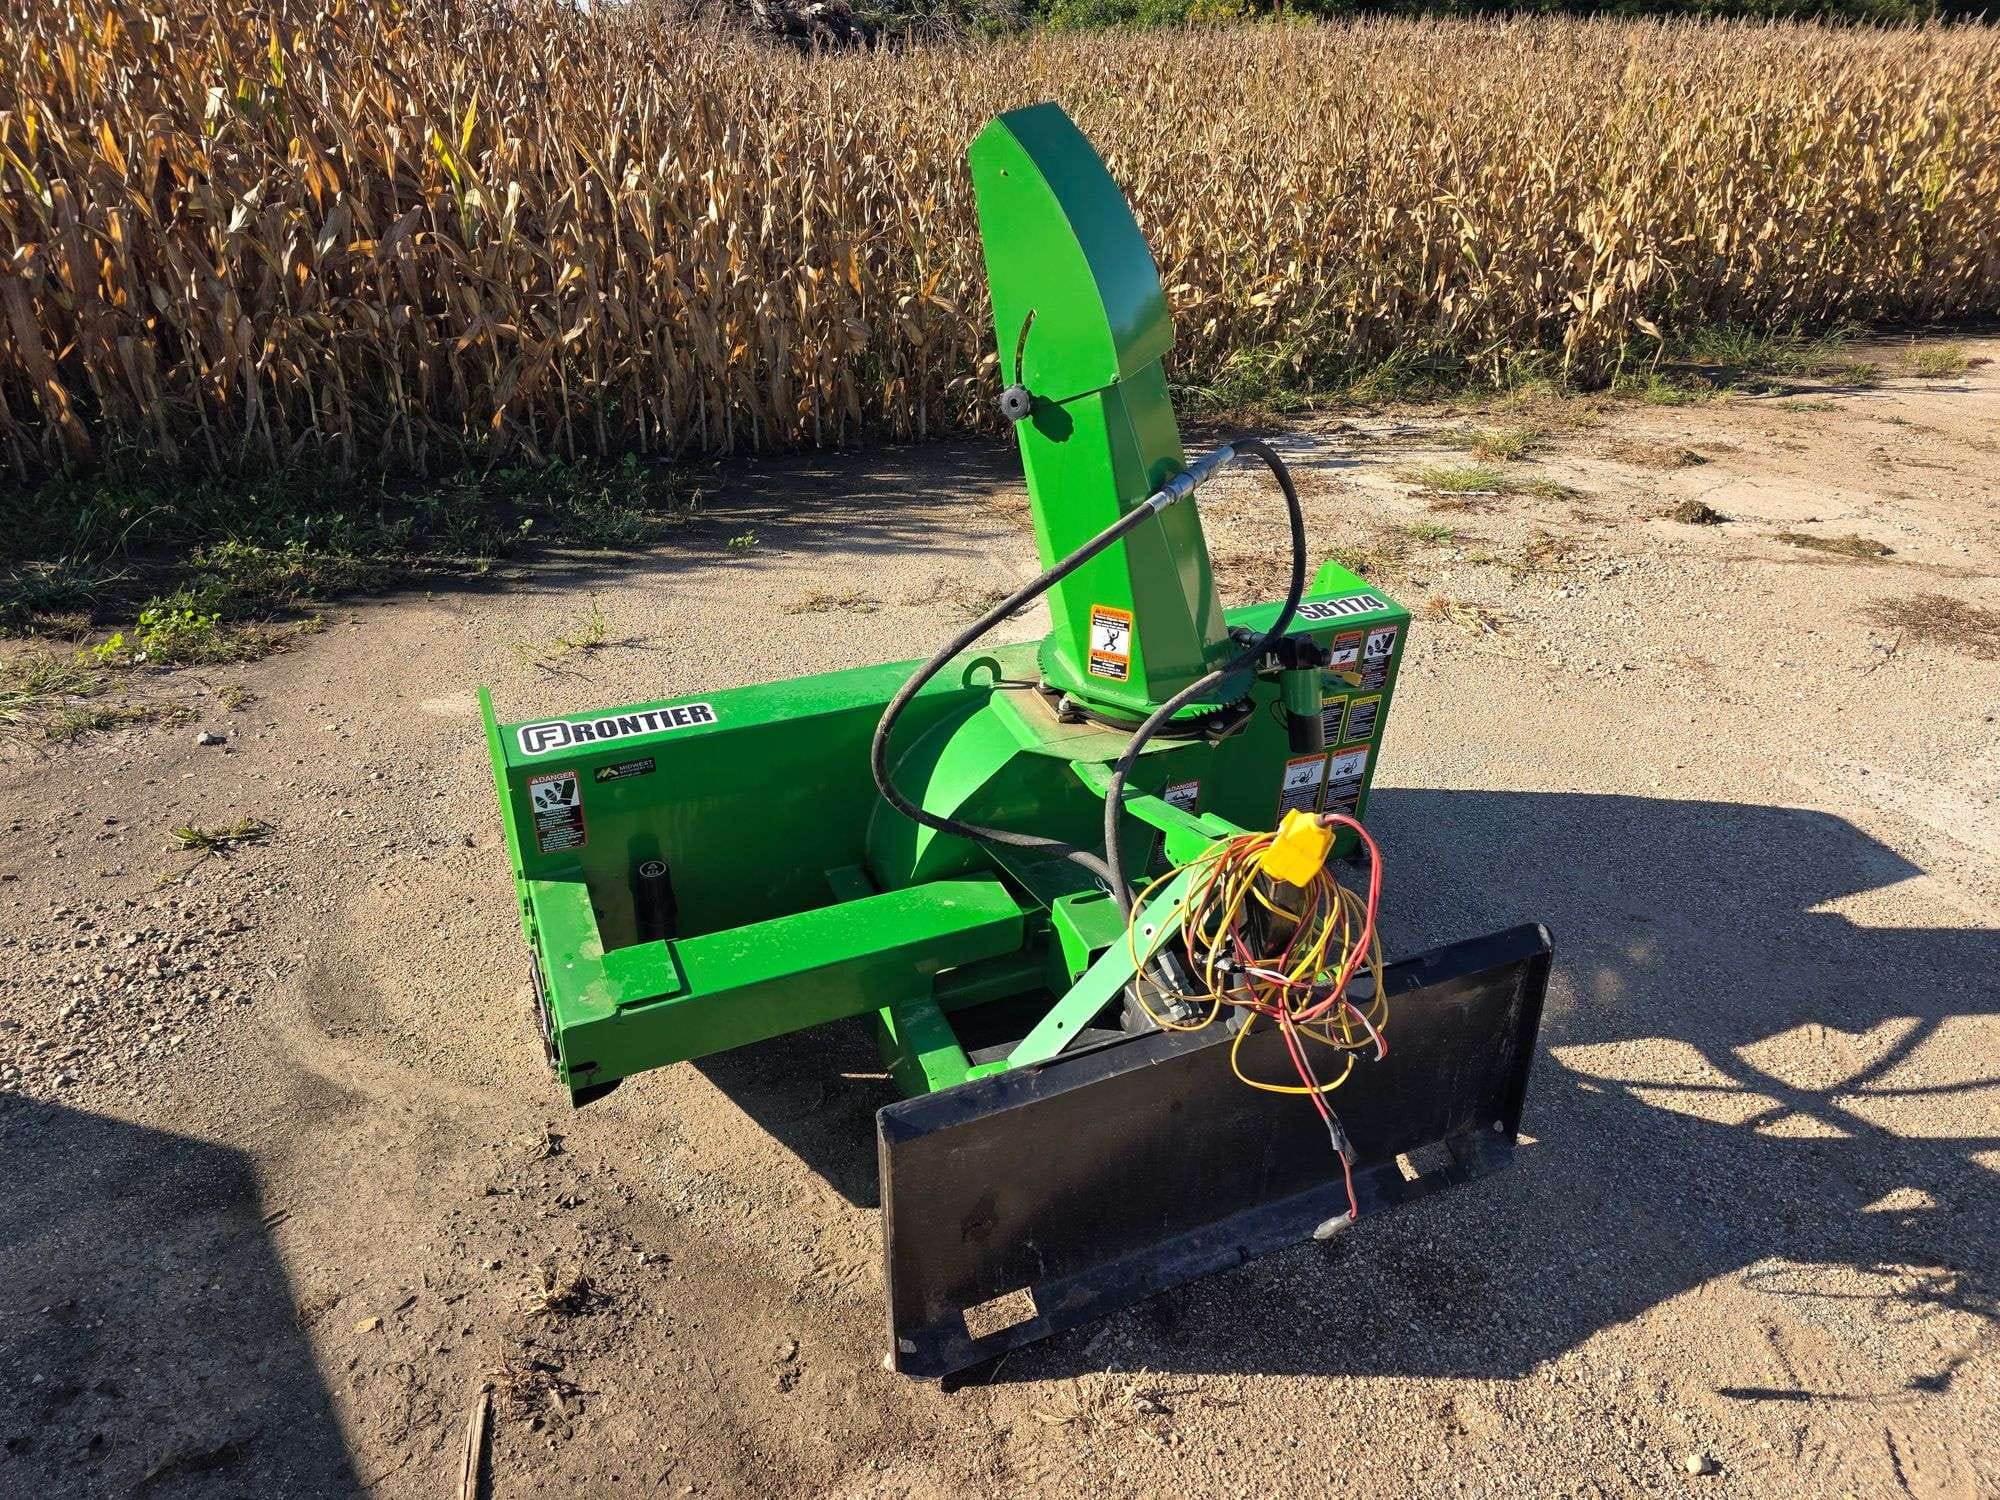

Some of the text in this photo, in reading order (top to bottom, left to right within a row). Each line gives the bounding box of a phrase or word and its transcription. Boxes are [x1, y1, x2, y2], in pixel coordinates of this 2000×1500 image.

[1296, 596, 1384, 619] SB1174
[522, 705, 713, 753] FRONTIER
[538, 771, 576, 783] DANGER
